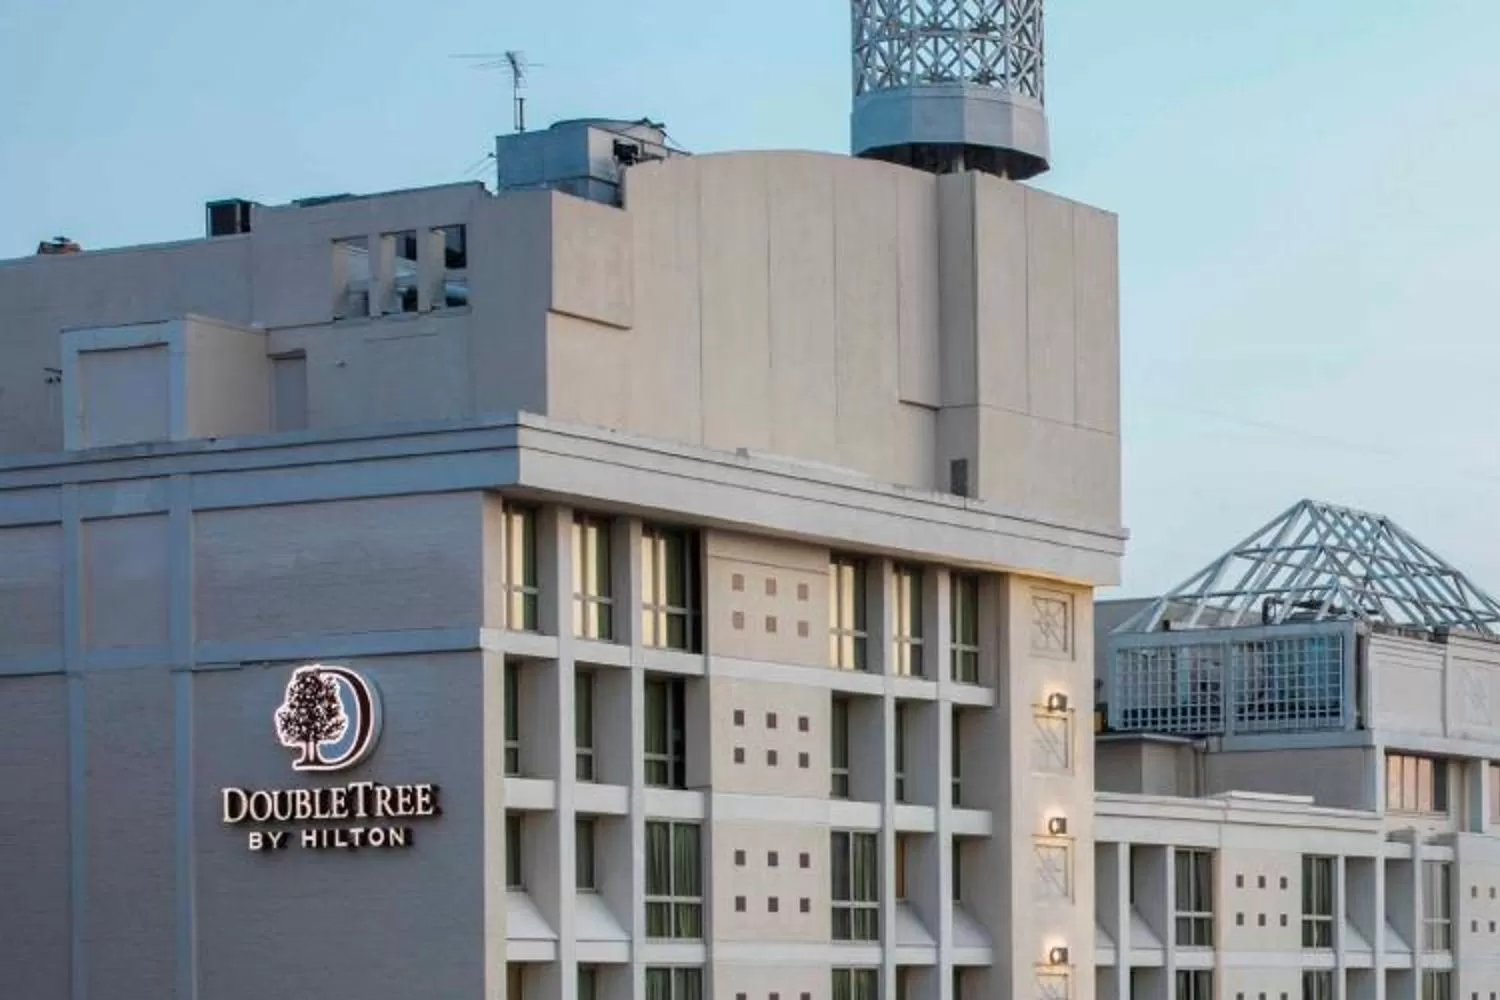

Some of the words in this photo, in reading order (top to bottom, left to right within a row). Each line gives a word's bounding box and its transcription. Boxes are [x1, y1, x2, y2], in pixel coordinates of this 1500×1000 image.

[221, 781, 434, 823] DOUBLETREE
[248, 830, 283, 850] BY
[301, 826, 406, 849] HILTON
